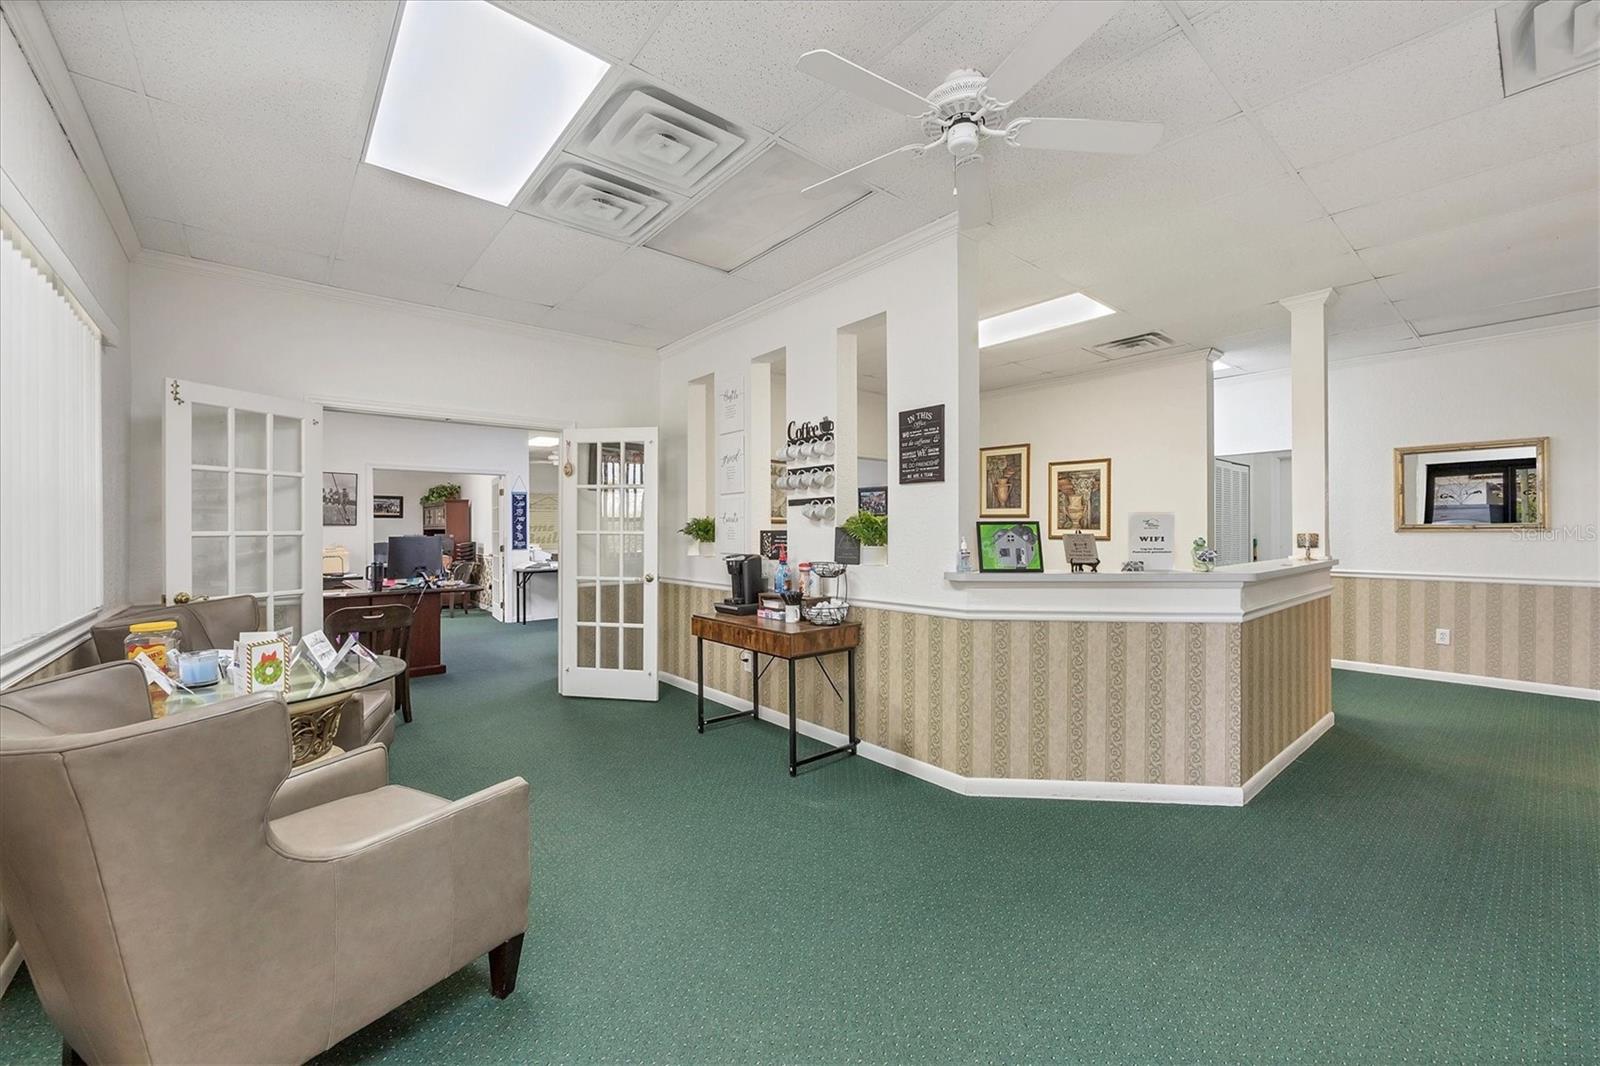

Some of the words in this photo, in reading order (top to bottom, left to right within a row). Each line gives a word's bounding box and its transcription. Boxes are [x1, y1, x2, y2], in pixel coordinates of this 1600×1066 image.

[907, 414, 915, 424] IN
[916, 412, 933, 420] THIS
[788, 420, 819, 441] Coffee
